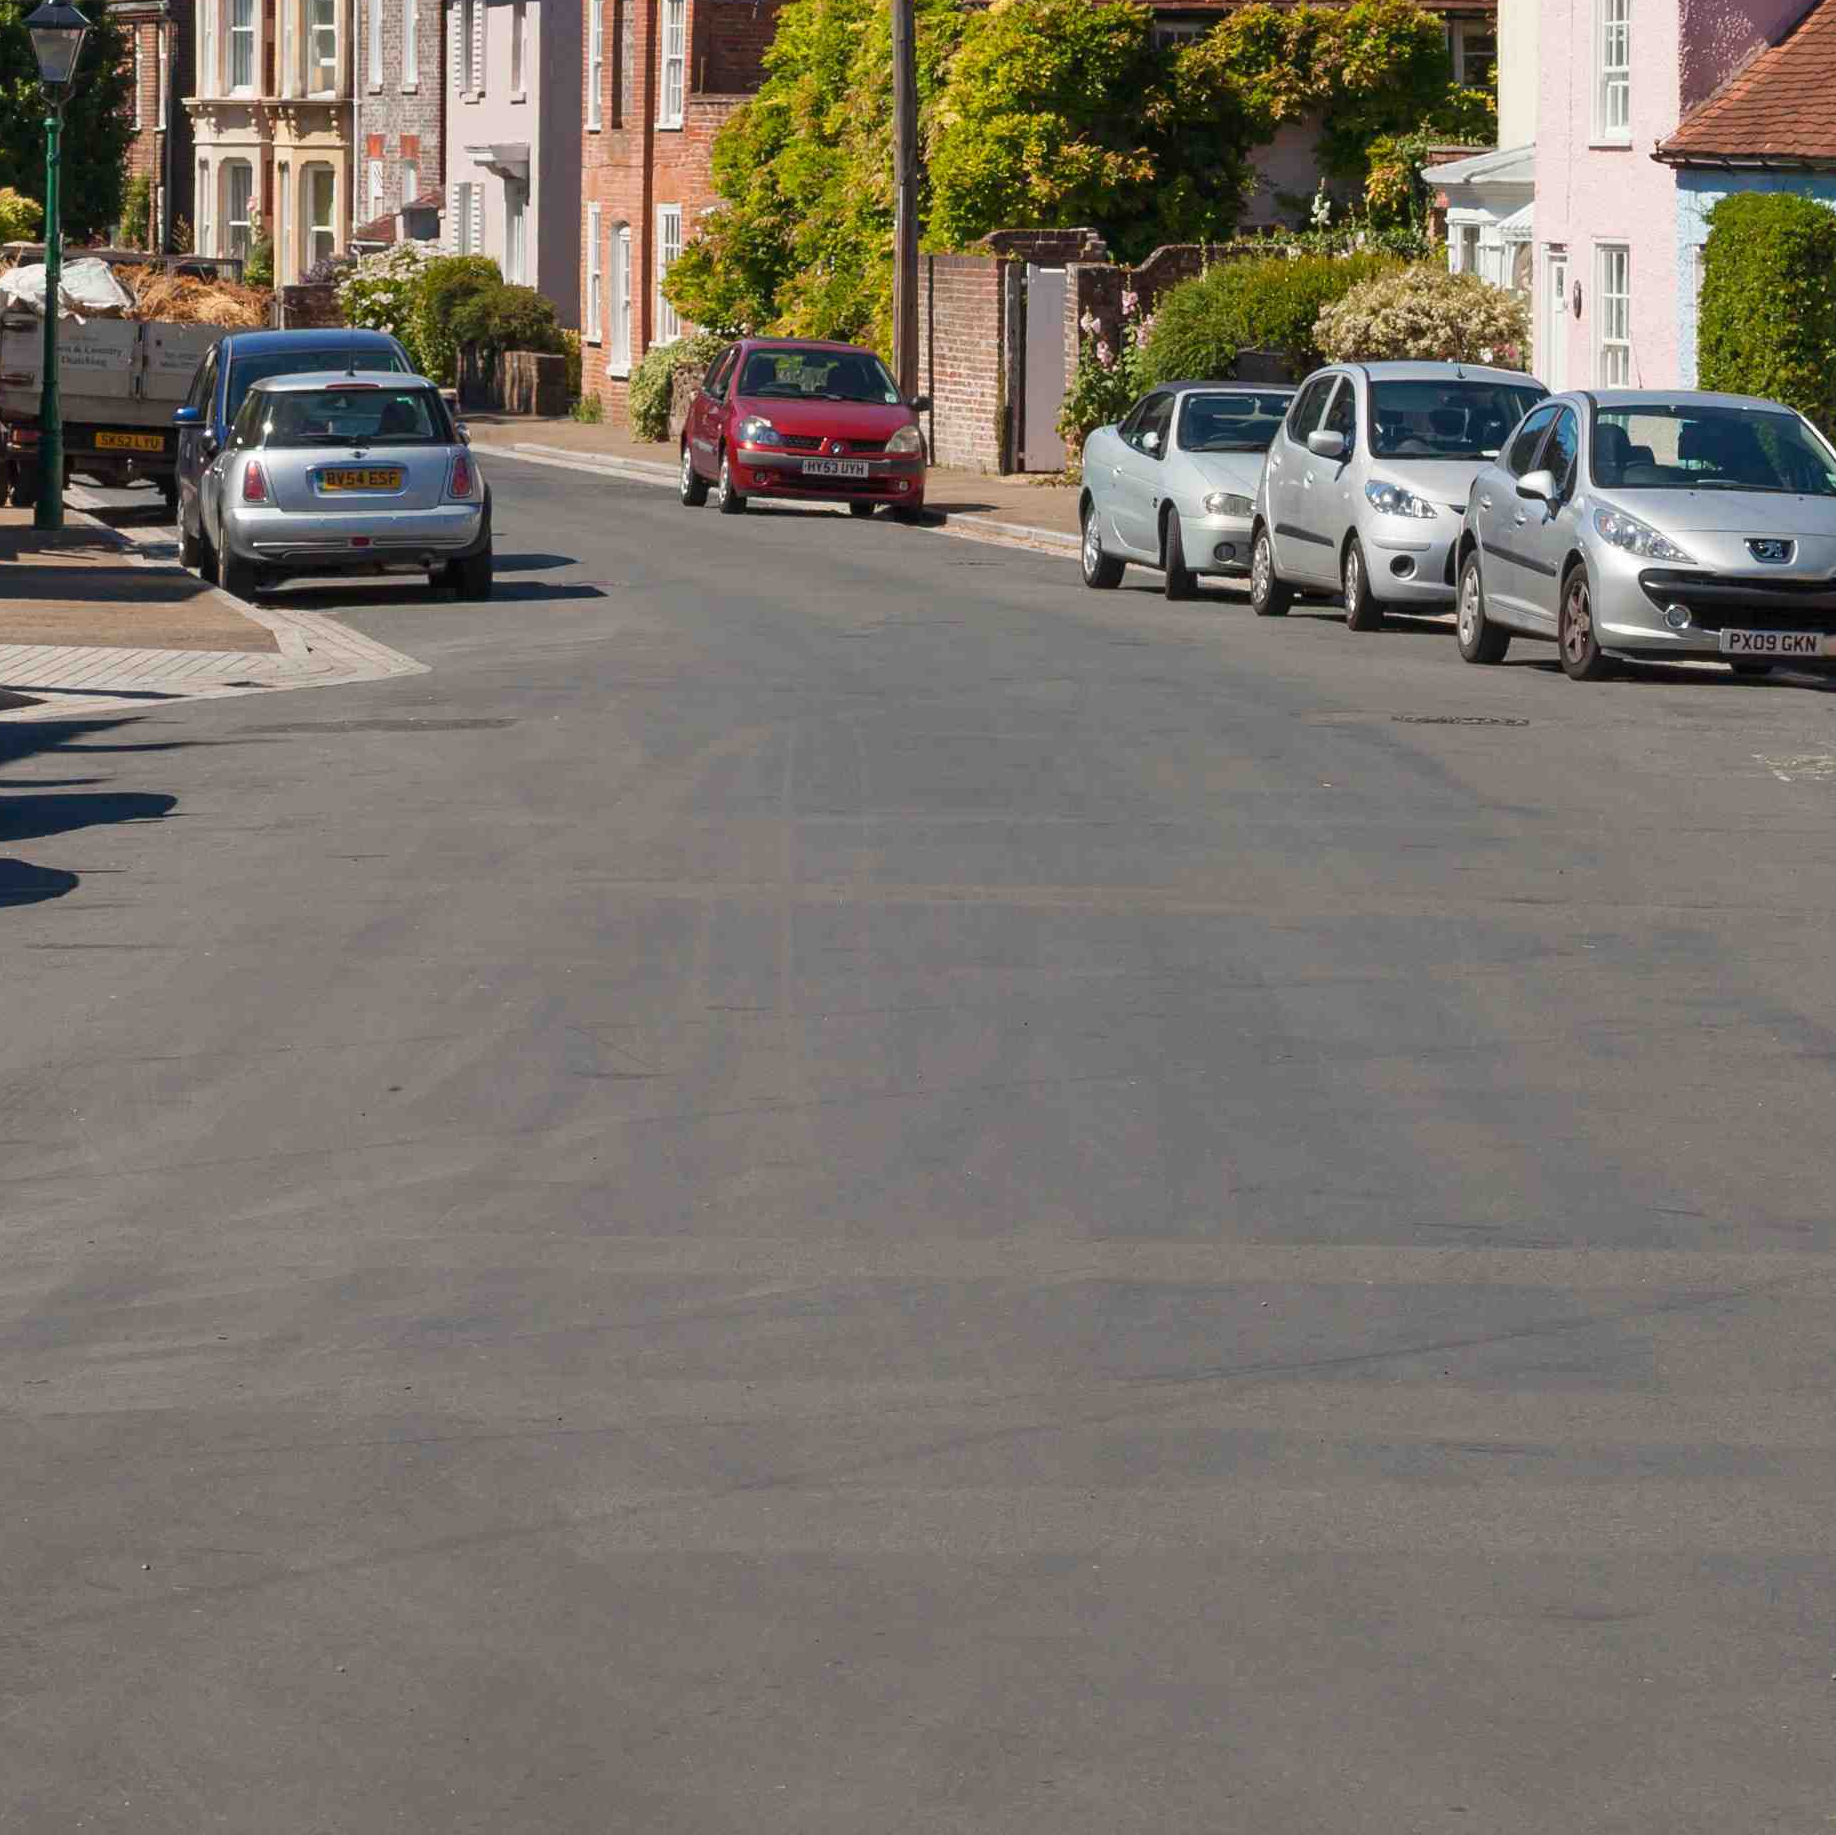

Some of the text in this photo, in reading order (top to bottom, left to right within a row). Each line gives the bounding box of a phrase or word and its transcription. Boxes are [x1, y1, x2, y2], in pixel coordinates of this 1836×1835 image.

[326, 471, 364, 485] BV54
[1730, 633, 1817, 652] PX09 GKN
